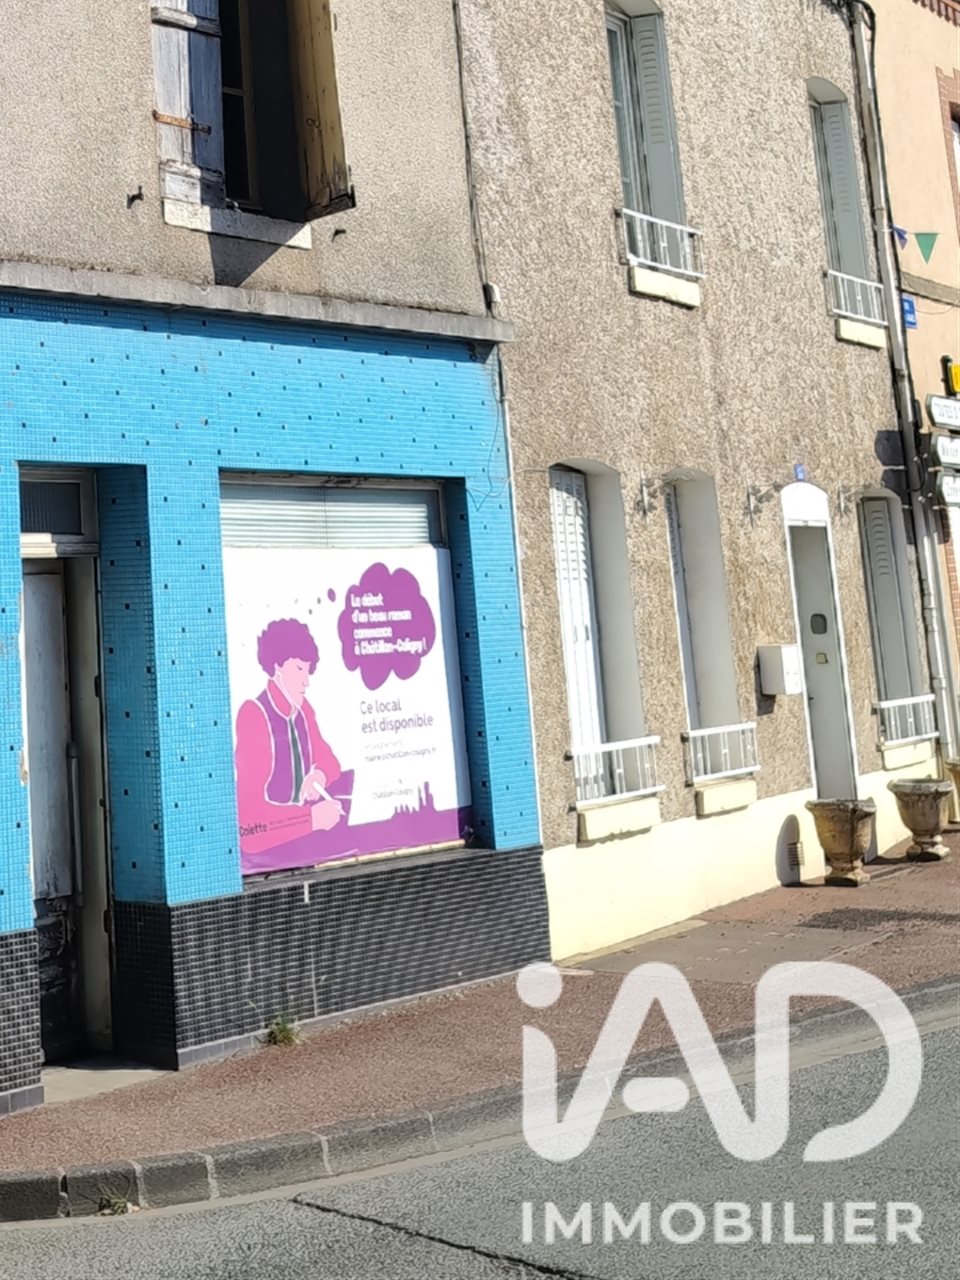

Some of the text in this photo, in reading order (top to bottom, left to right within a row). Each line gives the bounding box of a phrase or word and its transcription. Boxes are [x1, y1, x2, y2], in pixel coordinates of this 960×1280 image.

[350, 593, 361, 608] Le
[360, 697, 402, 715] Ce local
[361, 712, 434, 734] est disponible
[239, 822, 268, 838] Colette
